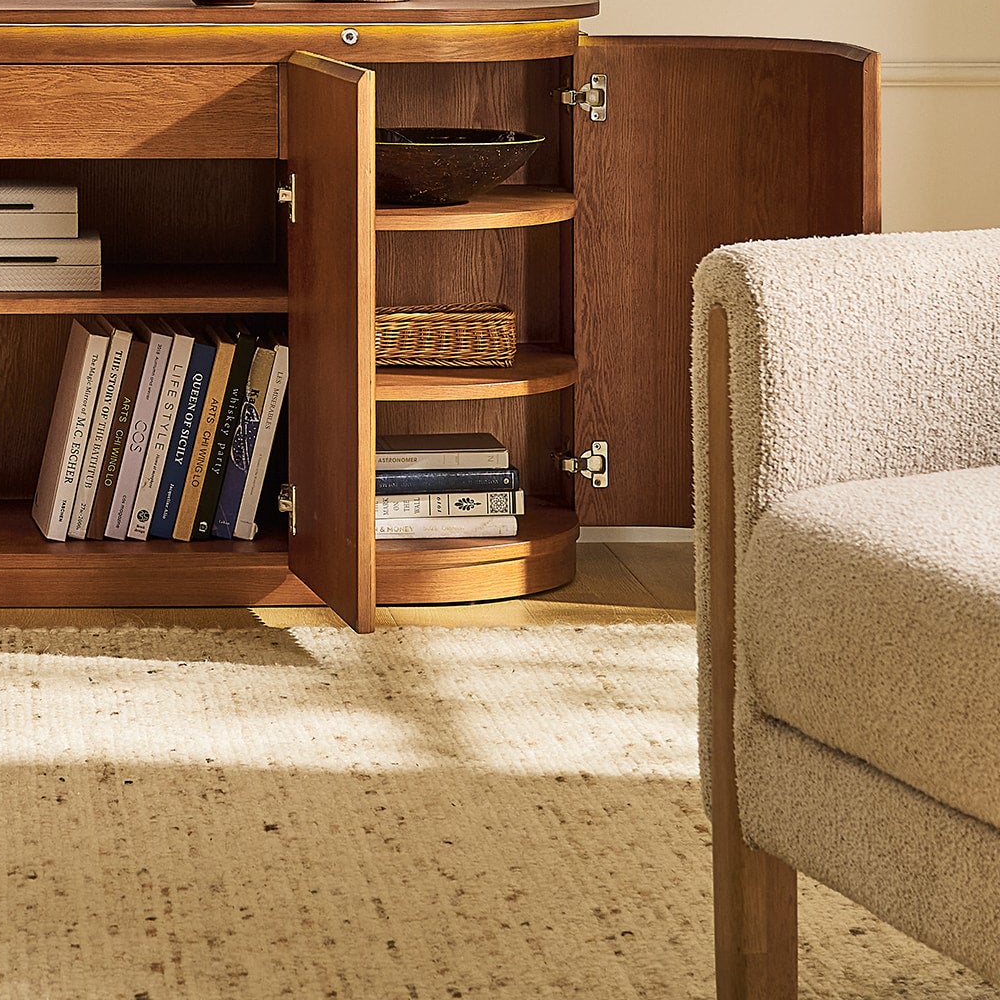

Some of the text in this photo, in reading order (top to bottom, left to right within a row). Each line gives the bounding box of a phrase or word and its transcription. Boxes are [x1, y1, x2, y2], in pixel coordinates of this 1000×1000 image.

[82, 386, 91, 407] Mirror
[86, 367, 95, 385] Magic
[73, 416, 86, 439] M.C.
[81, 407, 86, 415] of
[85, 350, 123, 488] THE STORY OF THE BATHTUB
[175, 373, 203, 465] QUEEN OF SICILY
[211, 388, 239, 474] whiskey party
[104, 397, 130, 486] ARTS CHI WING LO
[129, 420, 147, 453] COS
[191, 397, 218, 487] ARTS CHI WING LO
[64, 442, 80, 483] ESCHER
